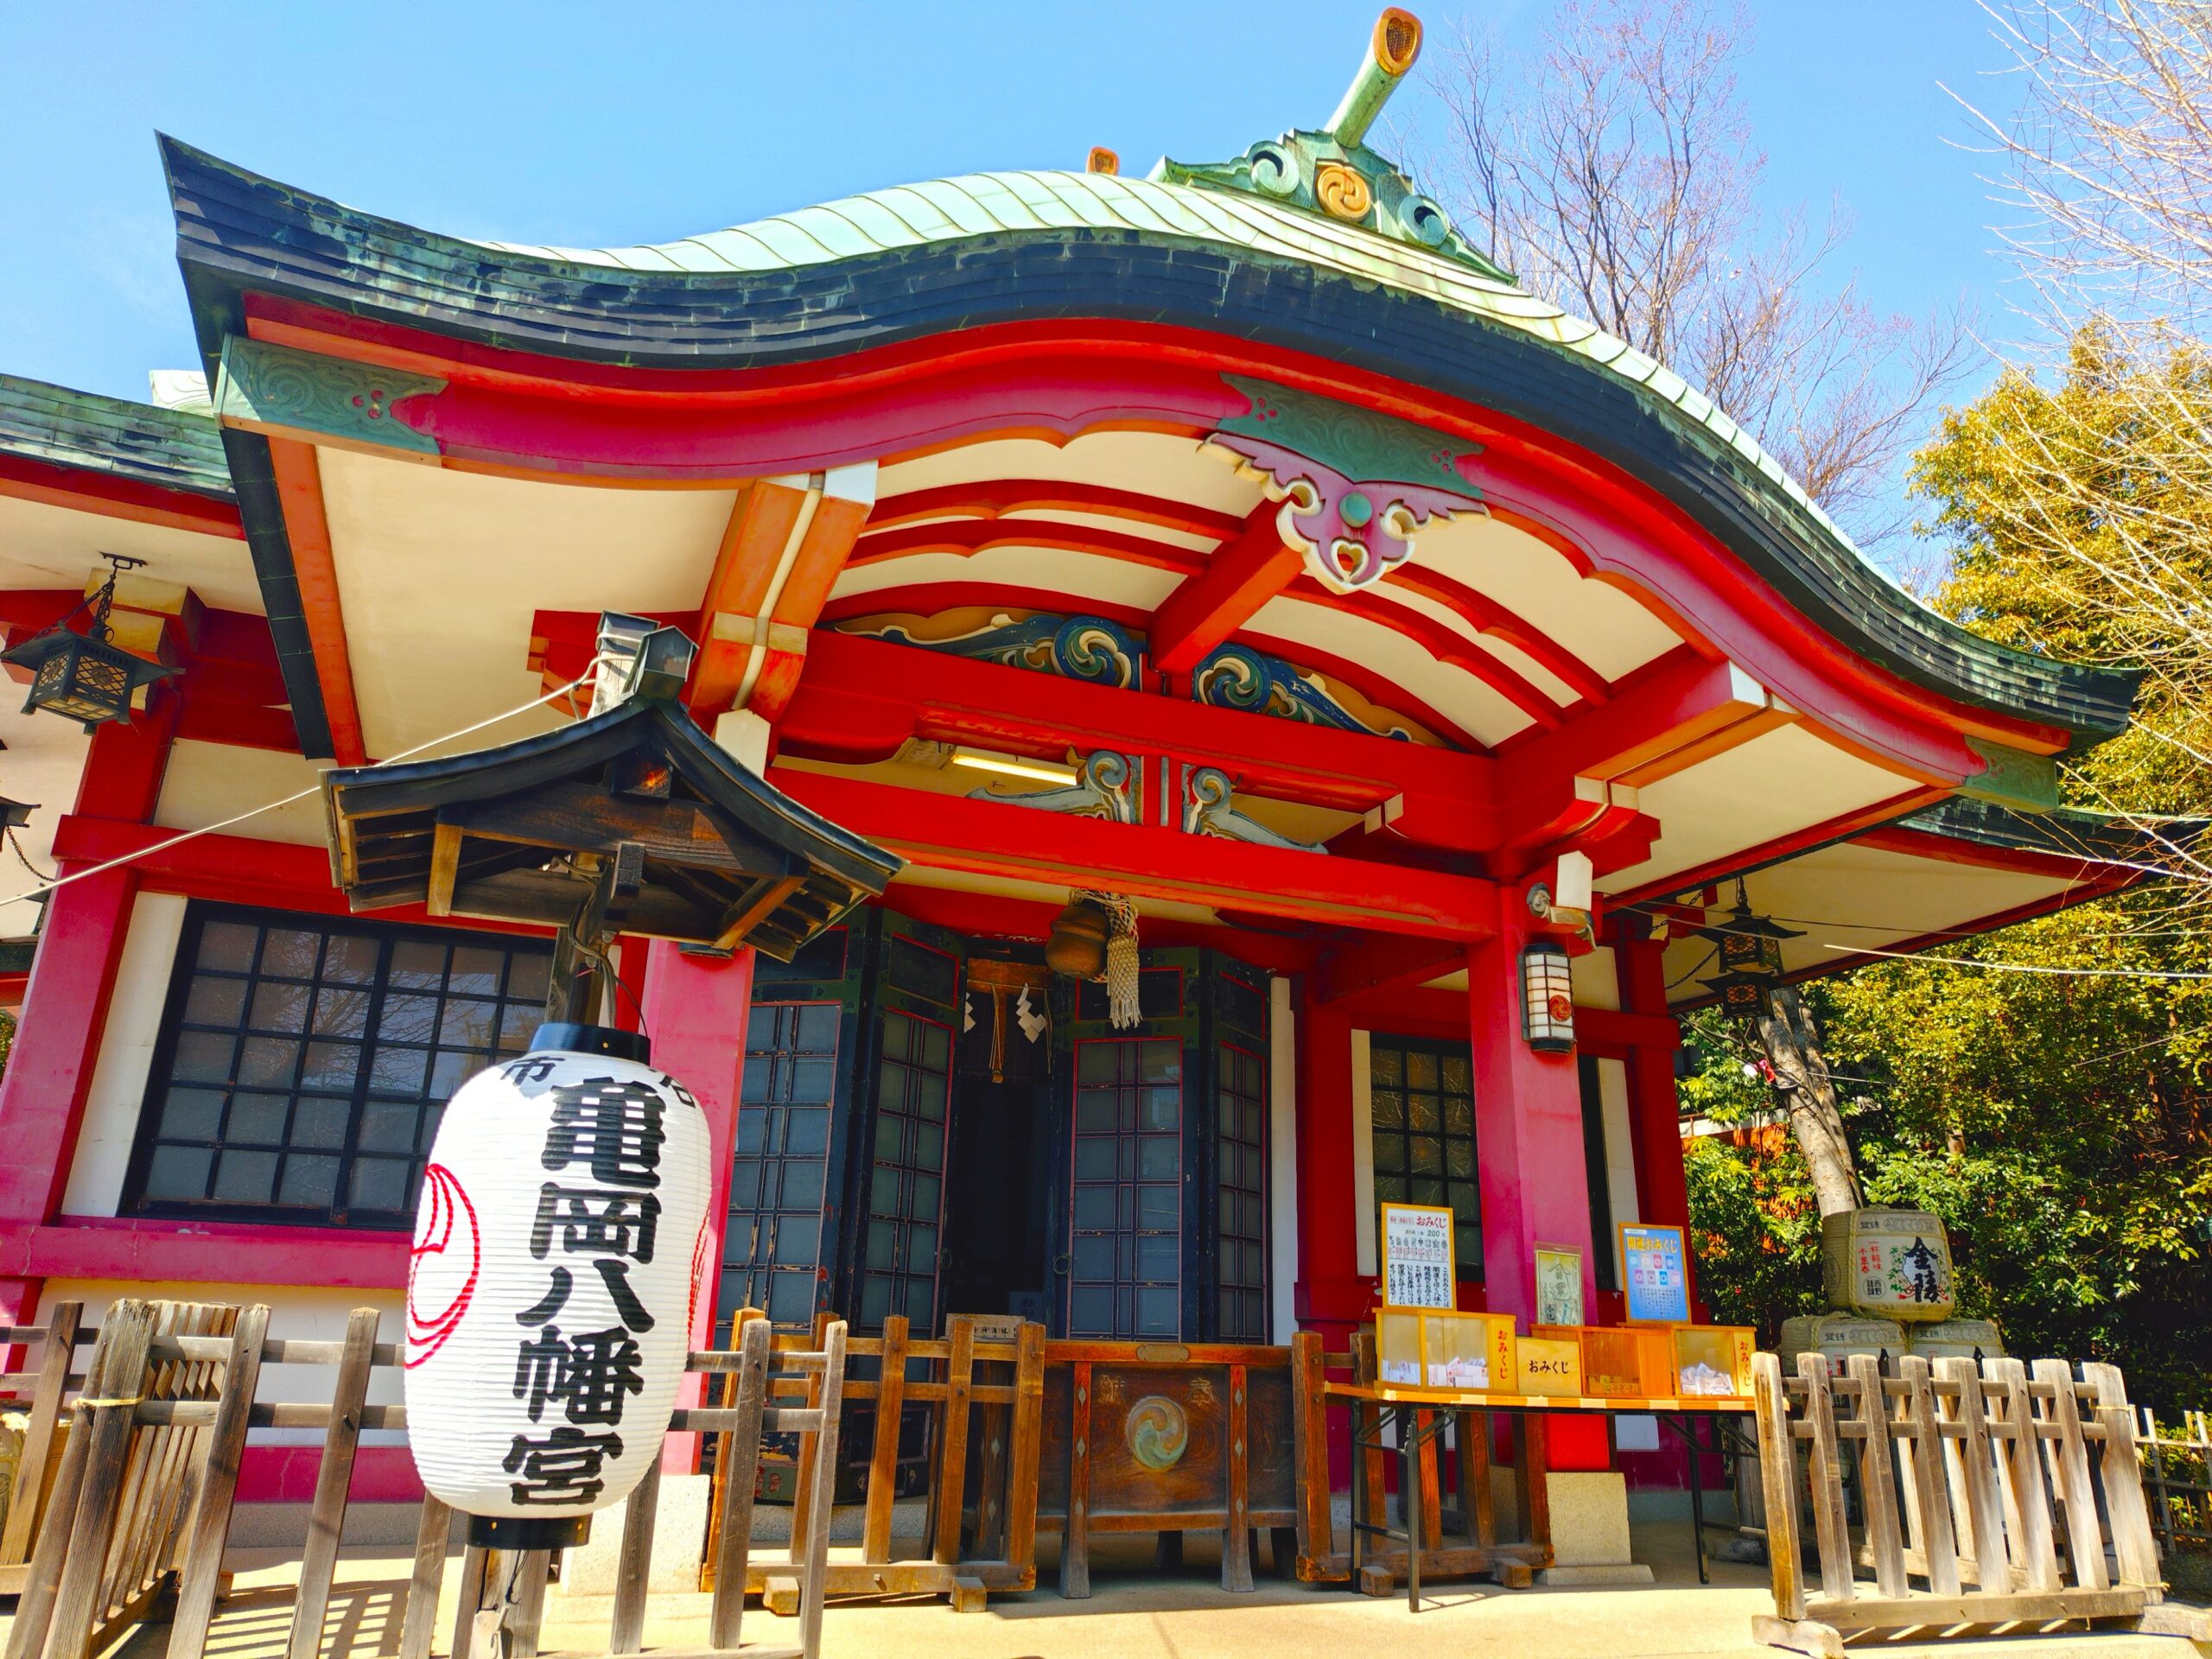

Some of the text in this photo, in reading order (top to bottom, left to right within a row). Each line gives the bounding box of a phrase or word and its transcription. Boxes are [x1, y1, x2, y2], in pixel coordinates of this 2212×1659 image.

[1416, 1216, 1446, 1229] おみくじ
[1627, 1236, 1678, 1253] 開運おみくじ
[1903, 1236, 1941, 1304] 金陵
[1497, 1330, 1509, 1380] おみくじ
[1528, 1359, 1569, 1375] おみくじ
[1739, 1341, 1751, 1387] おみくじ
